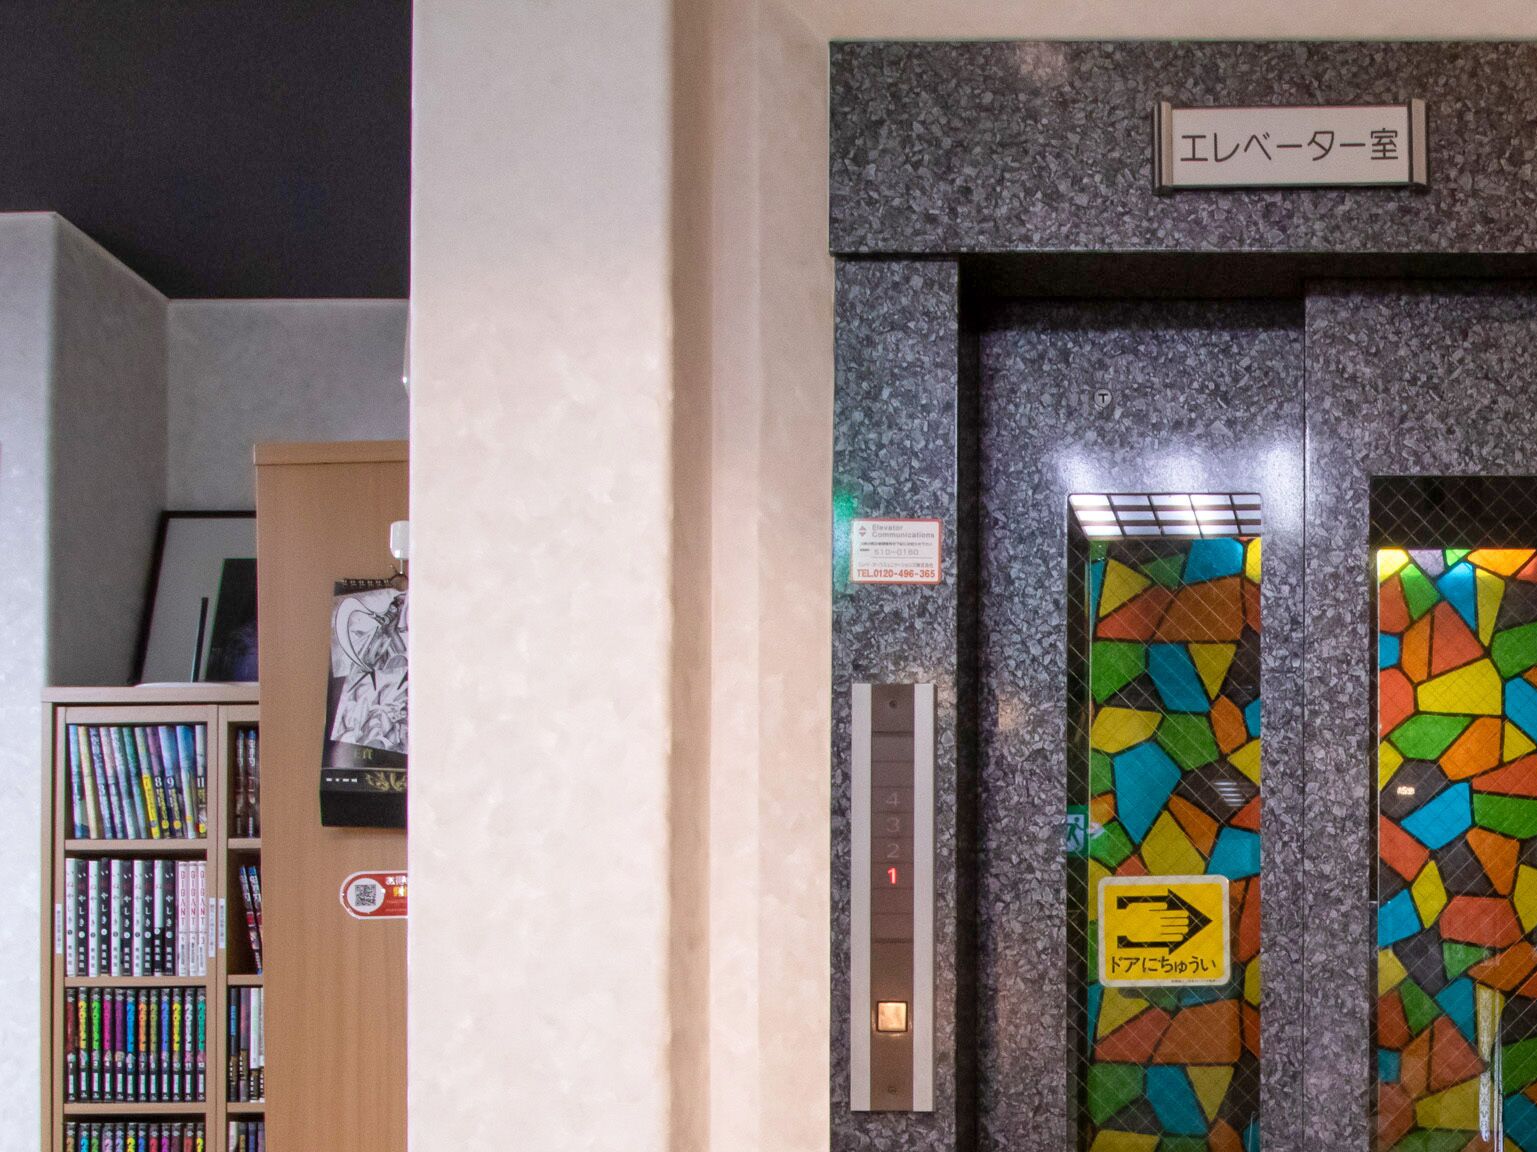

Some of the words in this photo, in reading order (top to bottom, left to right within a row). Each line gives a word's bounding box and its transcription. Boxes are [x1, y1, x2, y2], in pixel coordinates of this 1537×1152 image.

[1180, 127, 1399, 162] エレベーター室
[886, 792, 900, 807] 4
[886, 817, 900, 832] 3
[887, 843, 900, 858] 2
[887, 867, 897, 885] 1
[1110, 955, 1216, 974] ドアにちゅうい
